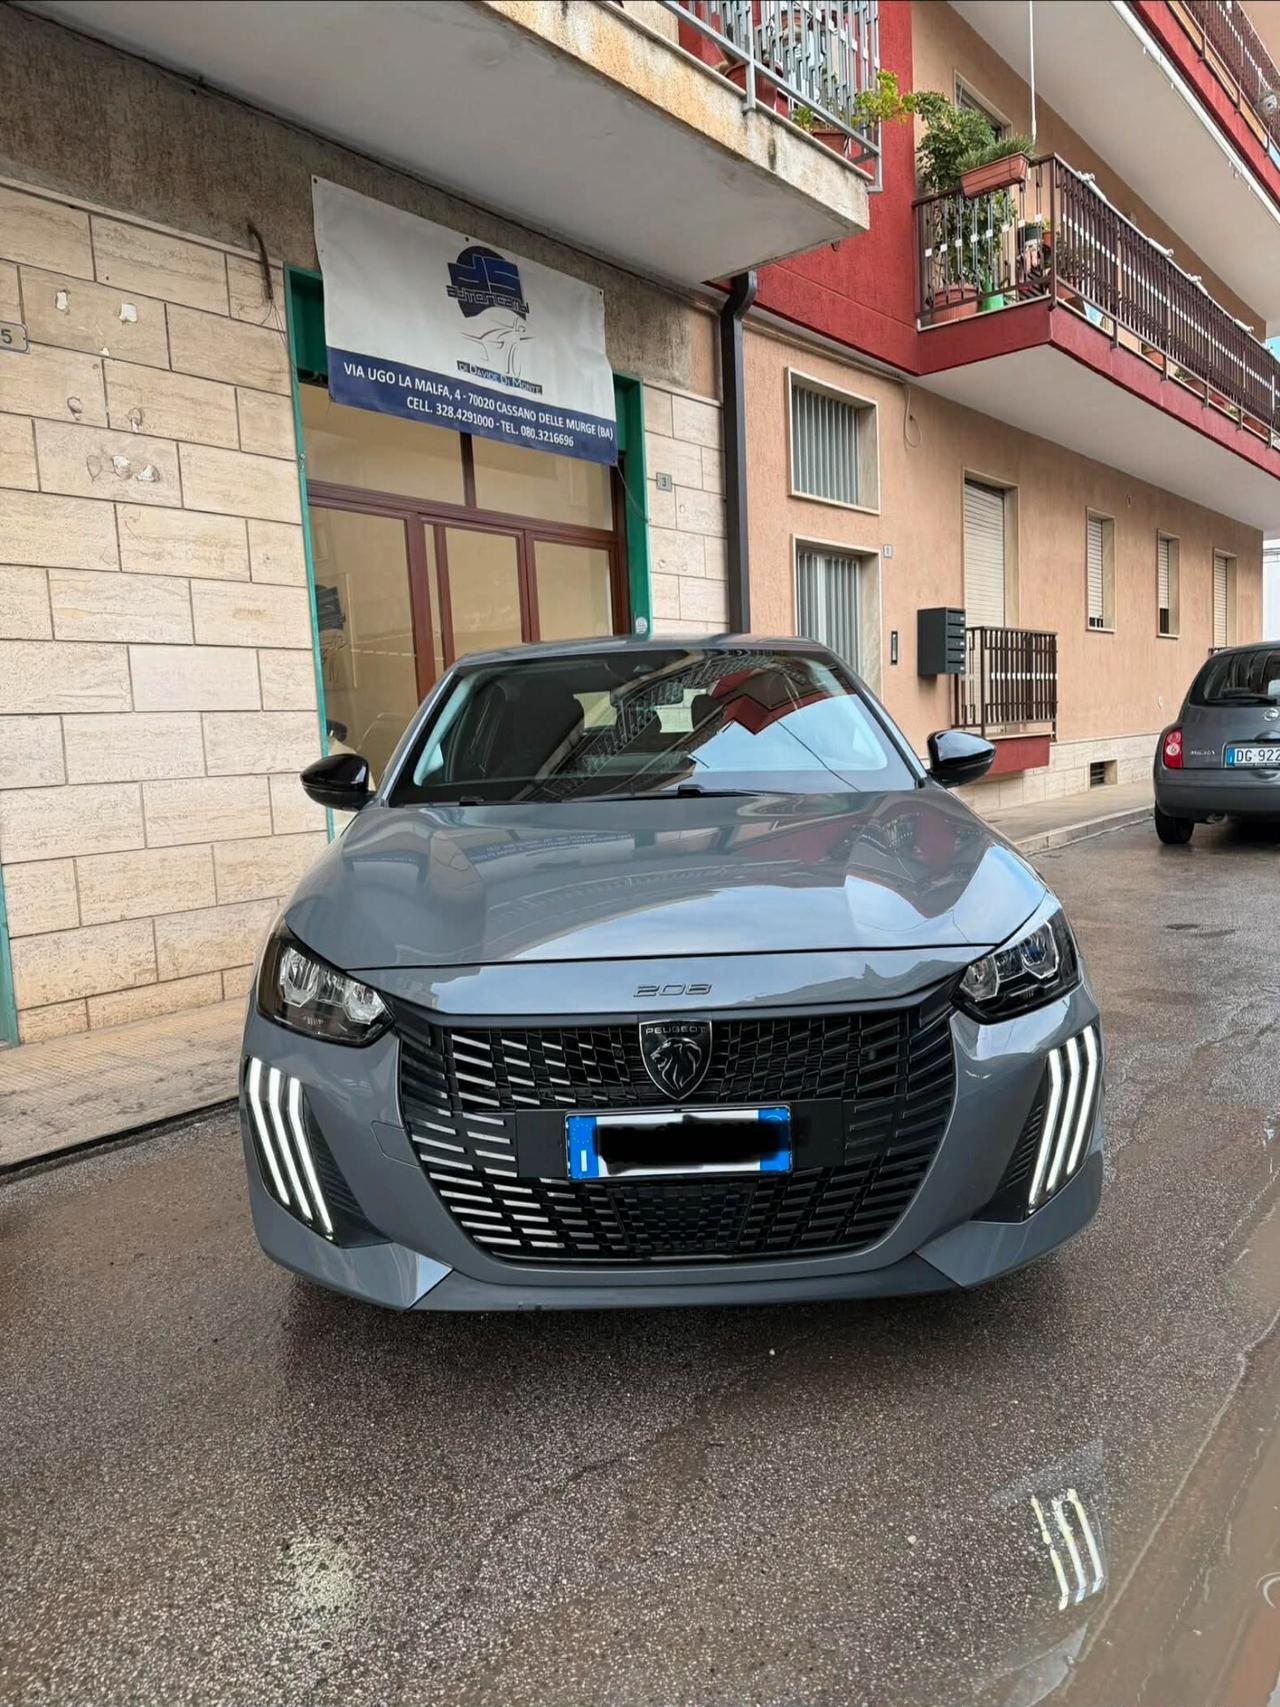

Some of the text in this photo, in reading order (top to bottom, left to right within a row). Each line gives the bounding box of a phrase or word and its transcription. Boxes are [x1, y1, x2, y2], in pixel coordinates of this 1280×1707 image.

[344, 361, 365, 378] VIA
[368, 367, 396, 384] UGO
[398, 374, 412, 388] LA
[415, 378, 453, 401] MALFA,
[454, 388, 461, 401] 4
[468, 392, 495, 411] 70020
[496, 401, 536, 422] CASSANO
[538, 412, 565, 428] DELLE
[566, 418, 596, 435] MURGE
[597, 425, 614, 441] (BA)
[407, 396, 433, 413] CELL.
[436, 403, 495, 429] 328.4291000
[500, 420, 519, 435] TEL.
[520, 425, 575, 447] 080.3216696
[1237, 749, 1252, 762] DG
[633, 984, 712, 998] 208
[645, 1025, 707, 1035] PEUGEOT
